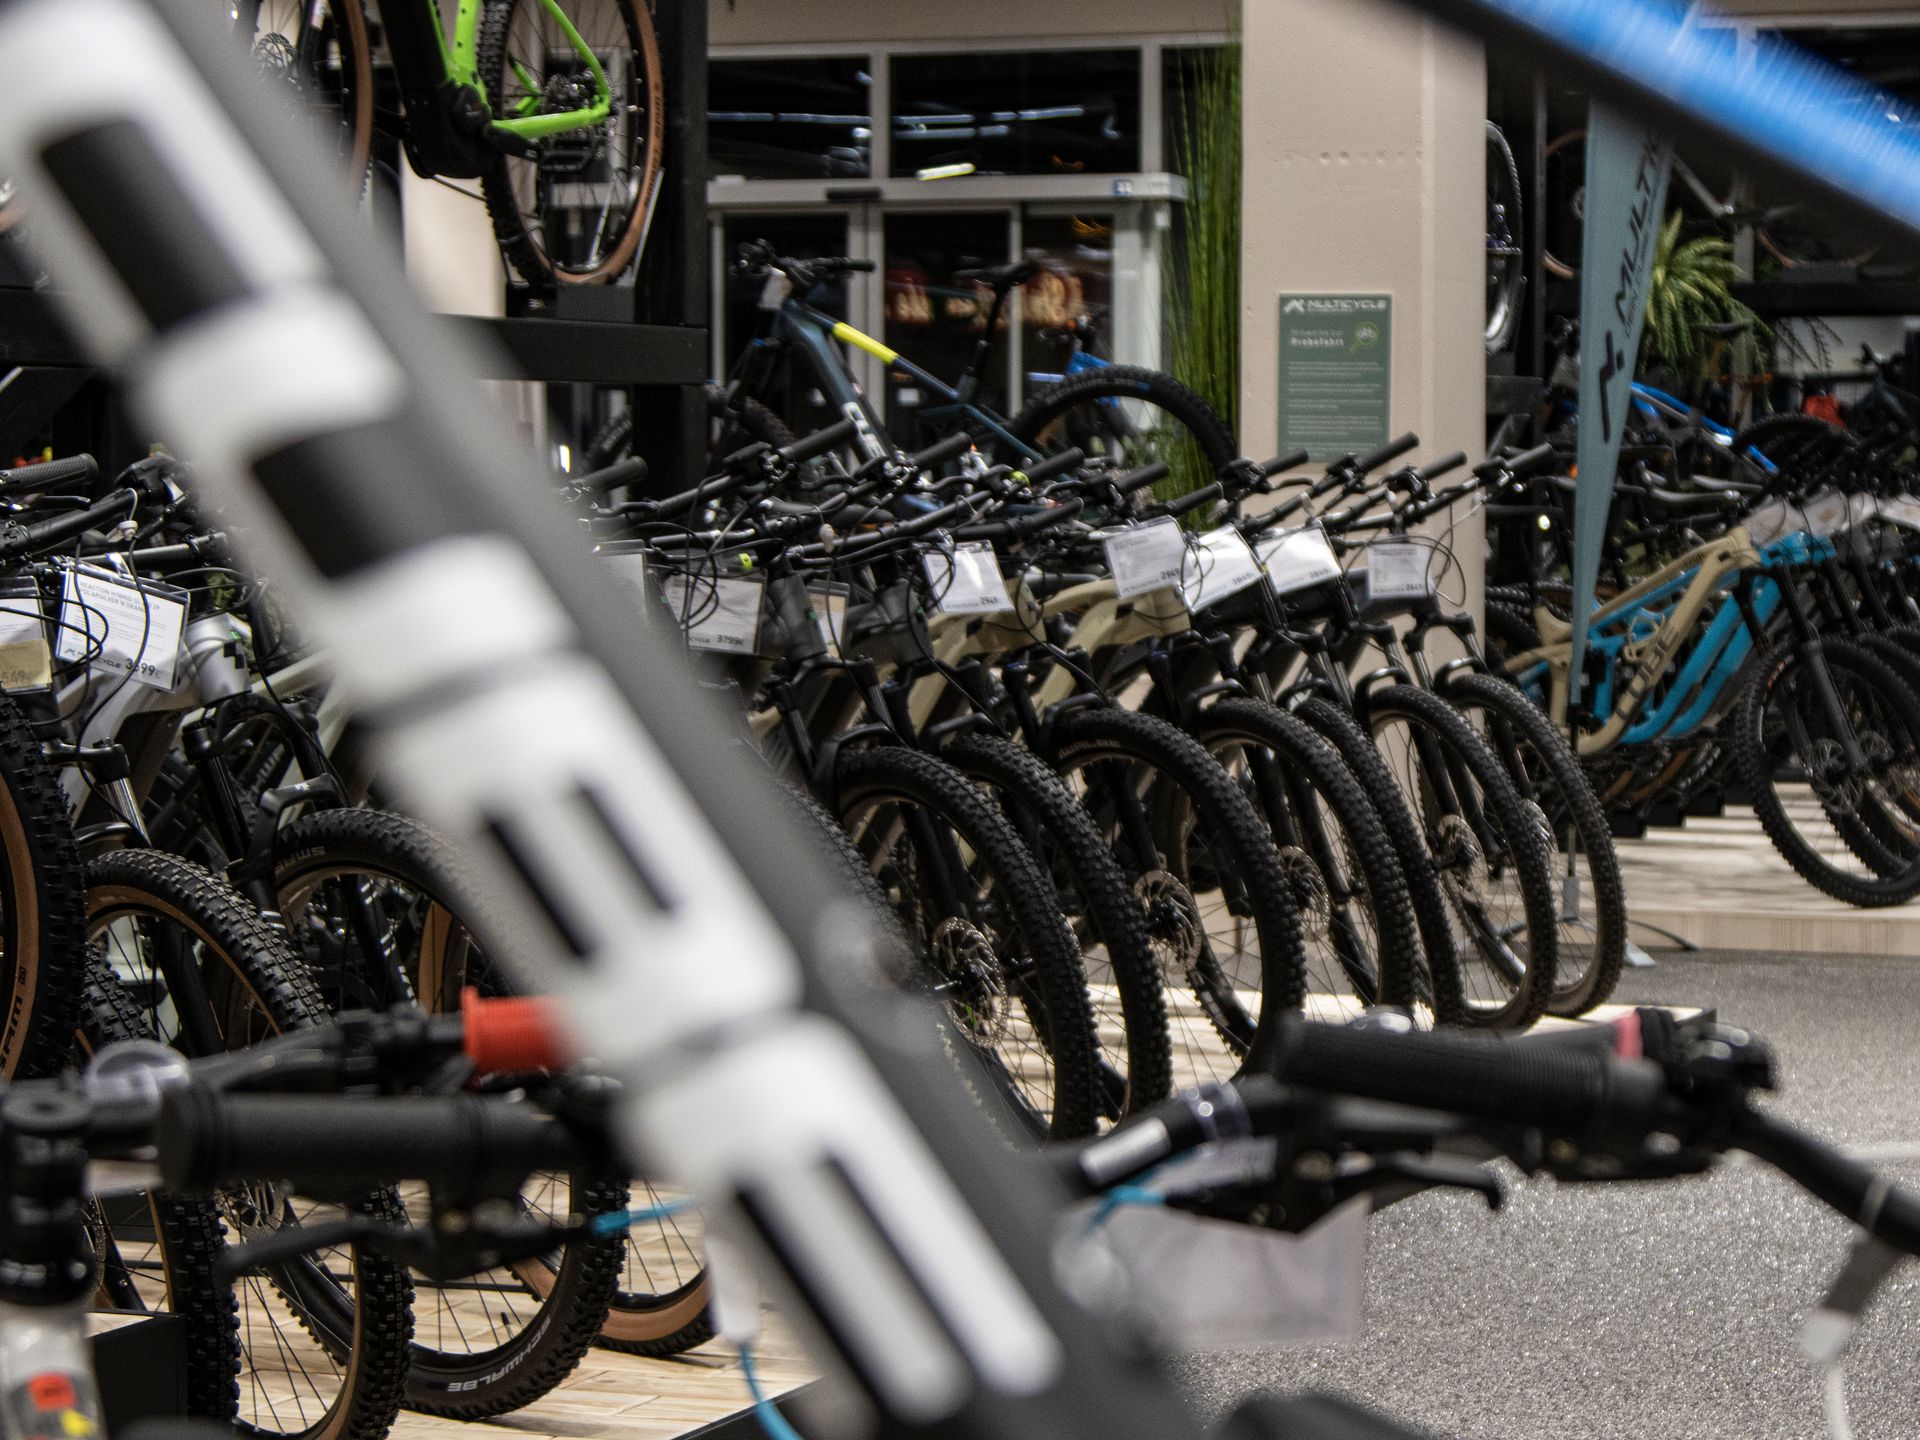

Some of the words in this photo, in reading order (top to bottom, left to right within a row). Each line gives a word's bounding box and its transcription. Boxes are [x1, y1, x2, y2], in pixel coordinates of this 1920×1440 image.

[1306, 299, 1387, 310] MULTICYCLE
[0, 0, 1065, 1440] CUBE
[446, 1317, 551, 1393] SCHWALBE
